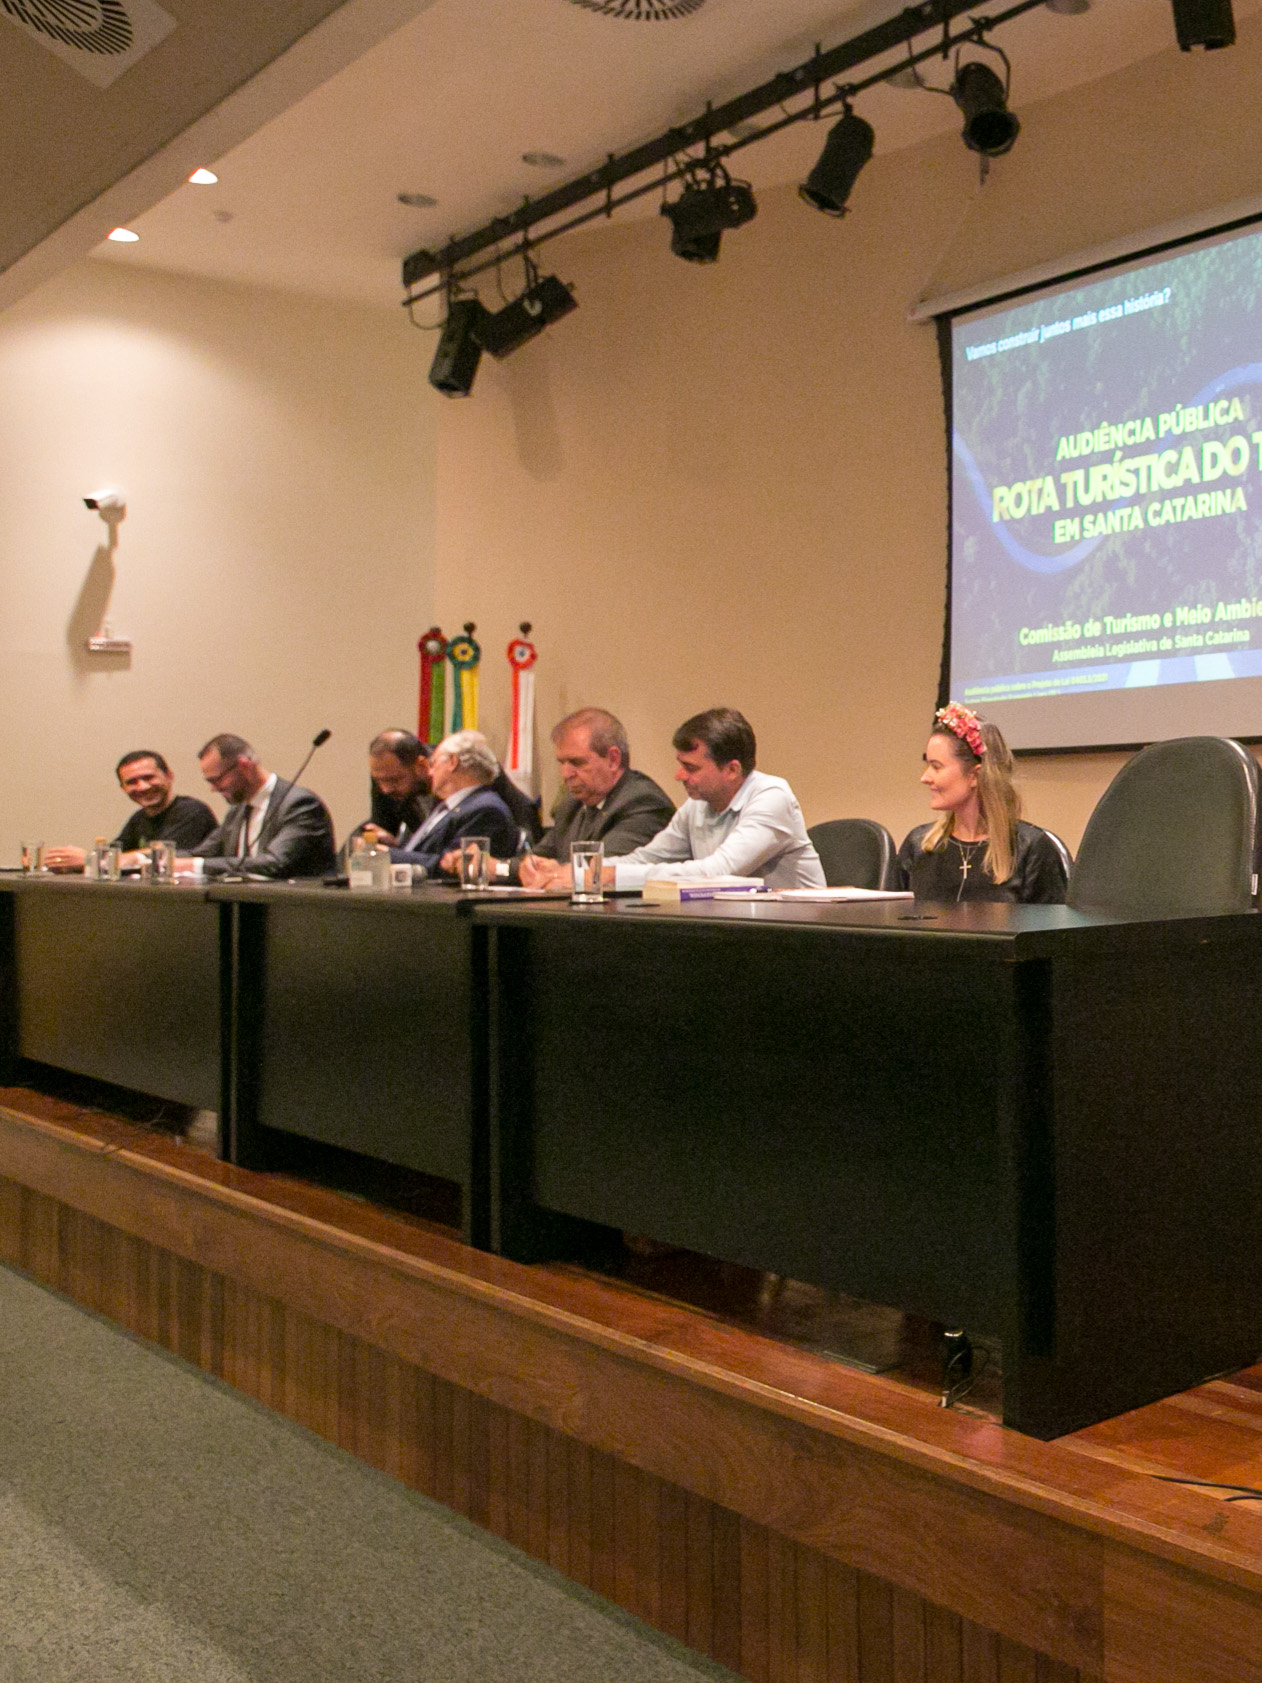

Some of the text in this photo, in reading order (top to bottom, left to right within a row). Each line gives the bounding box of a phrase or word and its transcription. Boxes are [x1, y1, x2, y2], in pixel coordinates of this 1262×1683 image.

[966, 287, 1171, 361] Vamos construir juntos mais essa história?
[1056, 397, 1244, 460] AUDIÊNCIA PÚBLICA
[992, 475, 1060, 522] ROTA
[1061, 446, 1200, 509] TURÍSTICA
[1202, 435, 1250, 481] DO
[1053, 486, 1247, 544] EM SANTA CATARINA
[1018, 621, 1081, 645] Comissão
[1083, 618, 1102, 636] de
[1103, 612, 1161, 635] Turismo
[1162, 612, 1172, 626] e
[1175, 604, 1211, 626] Meio
[1052, 628, 1250, 662] Assembleia Legislativa de Santa Catarina
